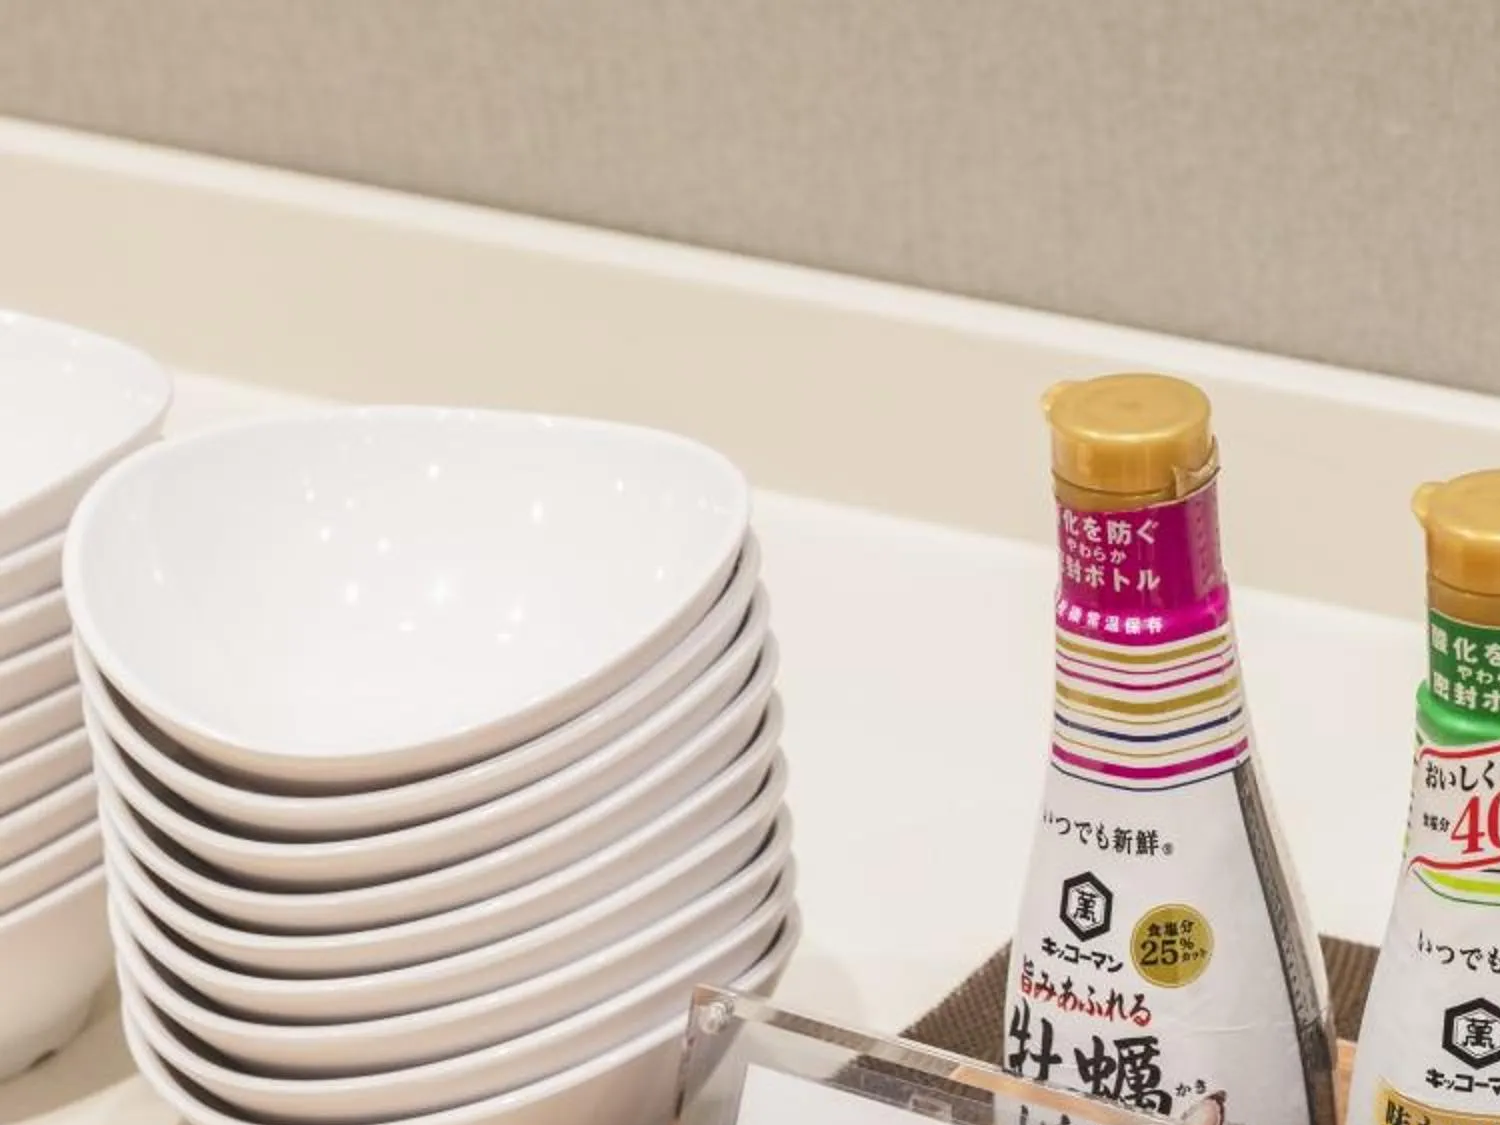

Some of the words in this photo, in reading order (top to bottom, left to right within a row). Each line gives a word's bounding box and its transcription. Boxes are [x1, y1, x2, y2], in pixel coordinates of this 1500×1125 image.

[1056, 505, 1159, 544] 化を防ぐ
[1067, 537, 1127, 565] やわらか
[1060, 553, 1160, 592] 封ボトル
[1041, 937, 1124, 973] キッコーマン
[1020, 953, 1152, 1027] 旨みあふれる
